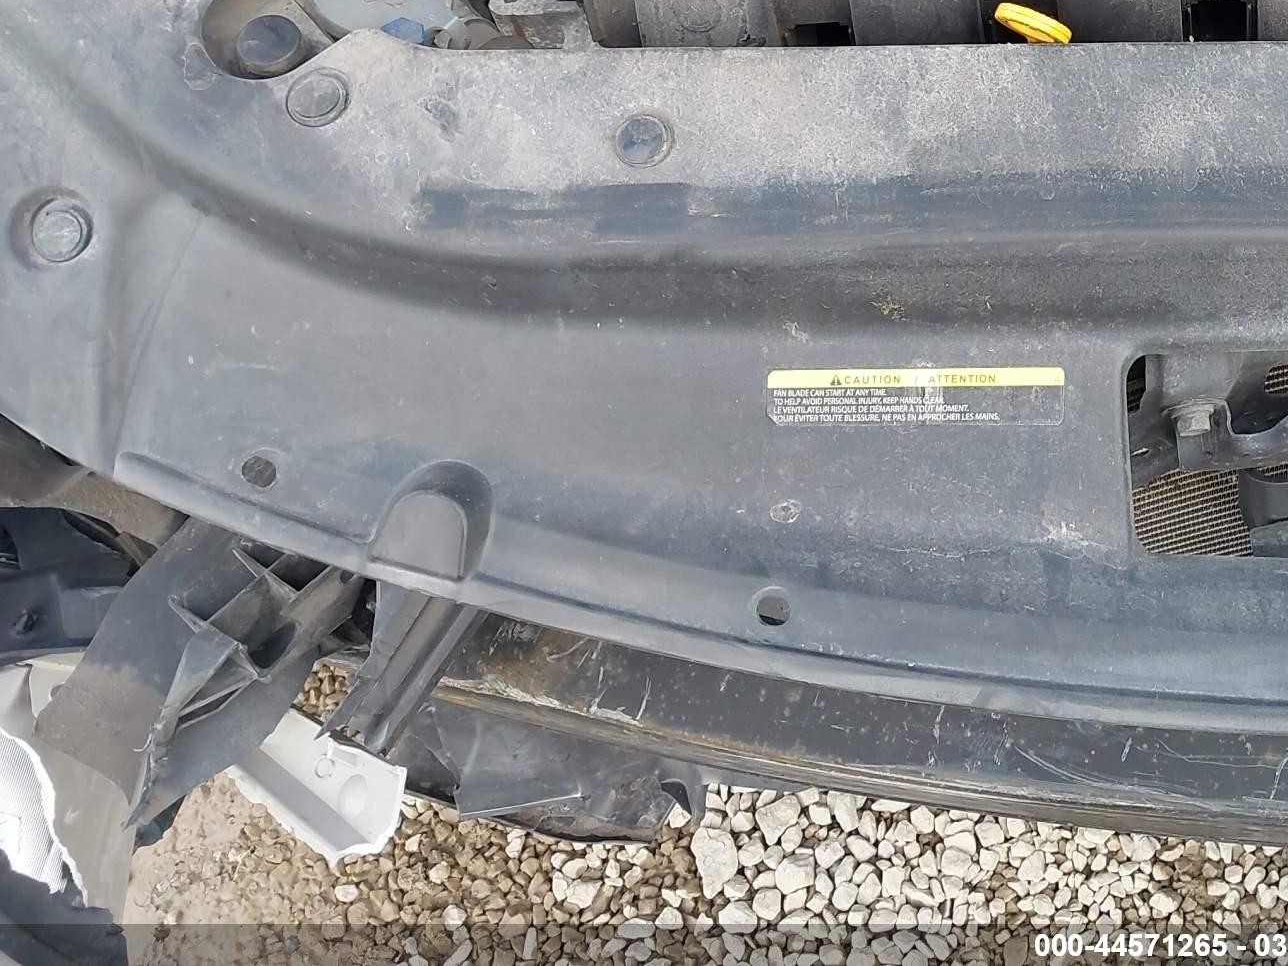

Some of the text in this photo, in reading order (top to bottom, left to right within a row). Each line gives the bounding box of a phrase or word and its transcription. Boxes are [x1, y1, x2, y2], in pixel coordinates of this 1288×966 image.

[844, 375, 902, 385] CAUTION
[927, 374, 997, 384] ATTENTION
[773, 389, 787, 397] FAN
[788, 389, 809, 397] BLADE
[810, 389, 825, 397] CAN
[825, 389, 844, 397] START
[774, 398, 784, 406] TO
[823, 397, 858, 405] PERSONAL
[882, 397, 899, 405] KEEP
[774, 403, 970, 414] LE VENTILATEUR RISQUE DE DÉMARRER À TOUT MOMENT.
[794, 413, 819, 422] ÉVITER
[819, 414, 845, 422] TOUTE
[907, 413, 917, 421] EN
[917, 413, 960, 421] APPROCHER
[961, 413, 975, 421] LES
